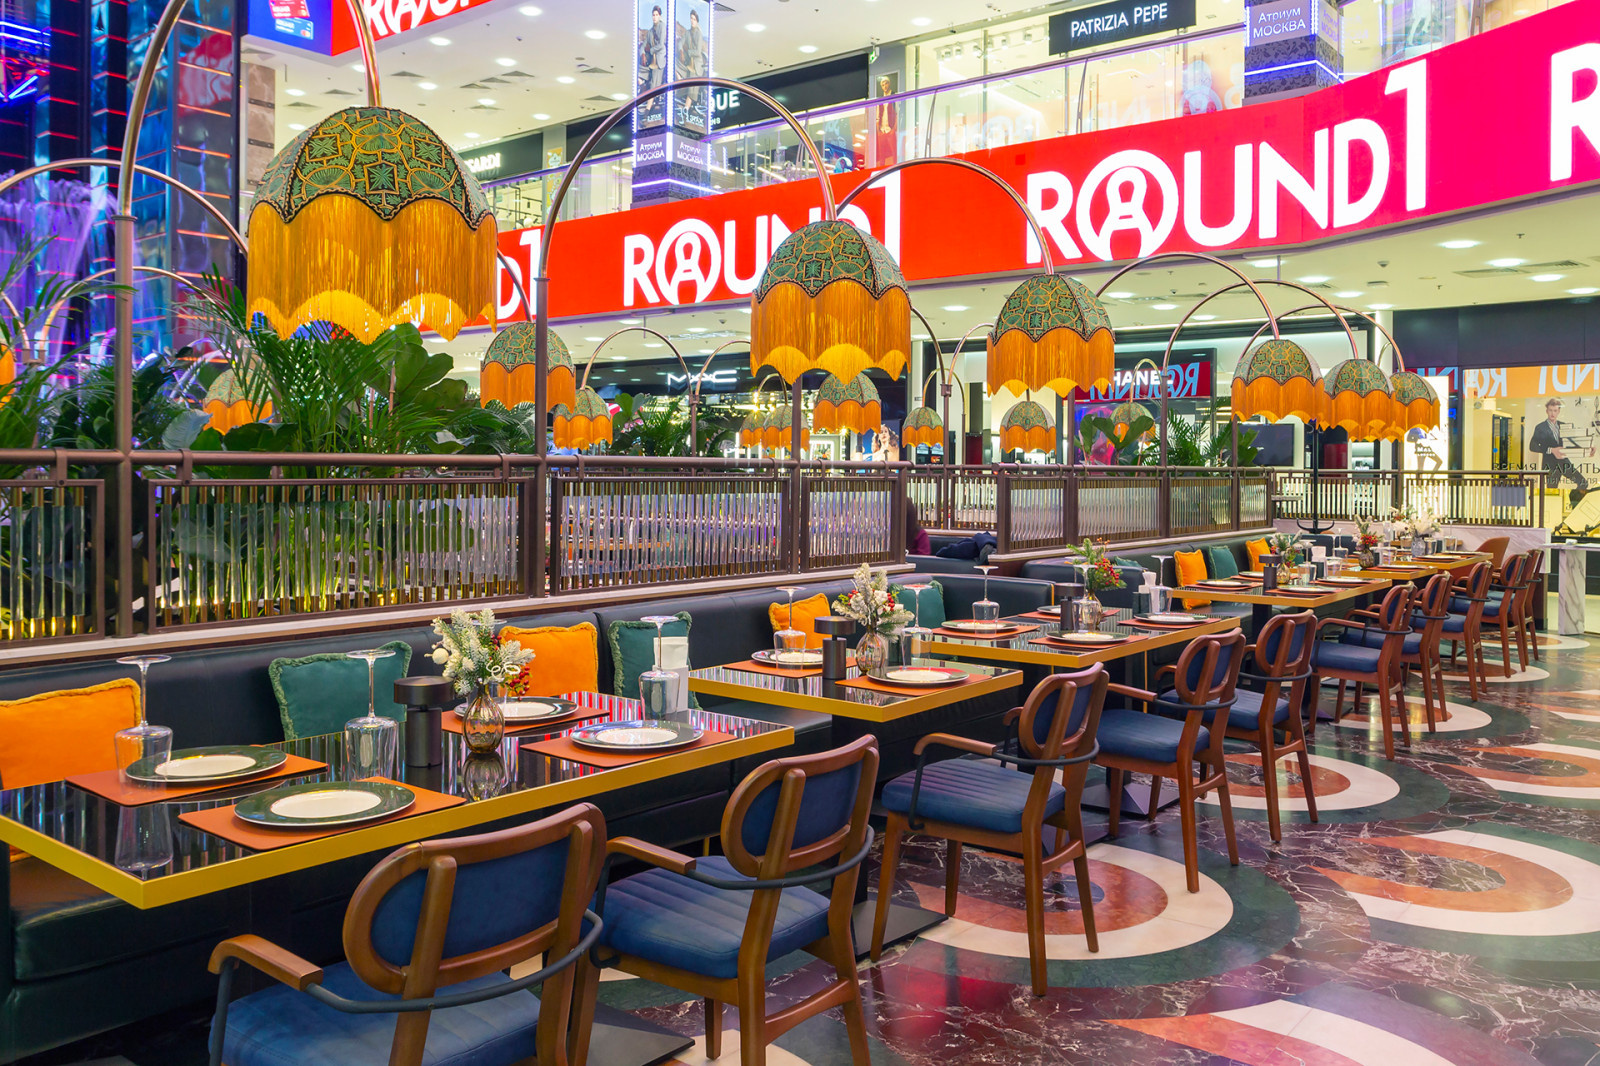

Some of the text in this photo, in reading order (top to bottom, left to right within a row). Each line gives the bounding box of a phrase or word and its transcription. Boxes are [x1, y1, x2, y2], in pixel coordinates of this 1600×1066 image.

[1071, 3, 1168, 38] PATRIZIA PEPE
[1258, 8, 1301, 24] Атриум
[1253, 19, 1306, 39] МОСКВА
[640, 141, 662, 151] Атриум
[637, 150, 665, 162] МОСКВА
[676, 151, 703, 165] МОСКВА
[1026, 59, 1427, 263] ROUND1
[1113, 369, 1174, 386] HANE
